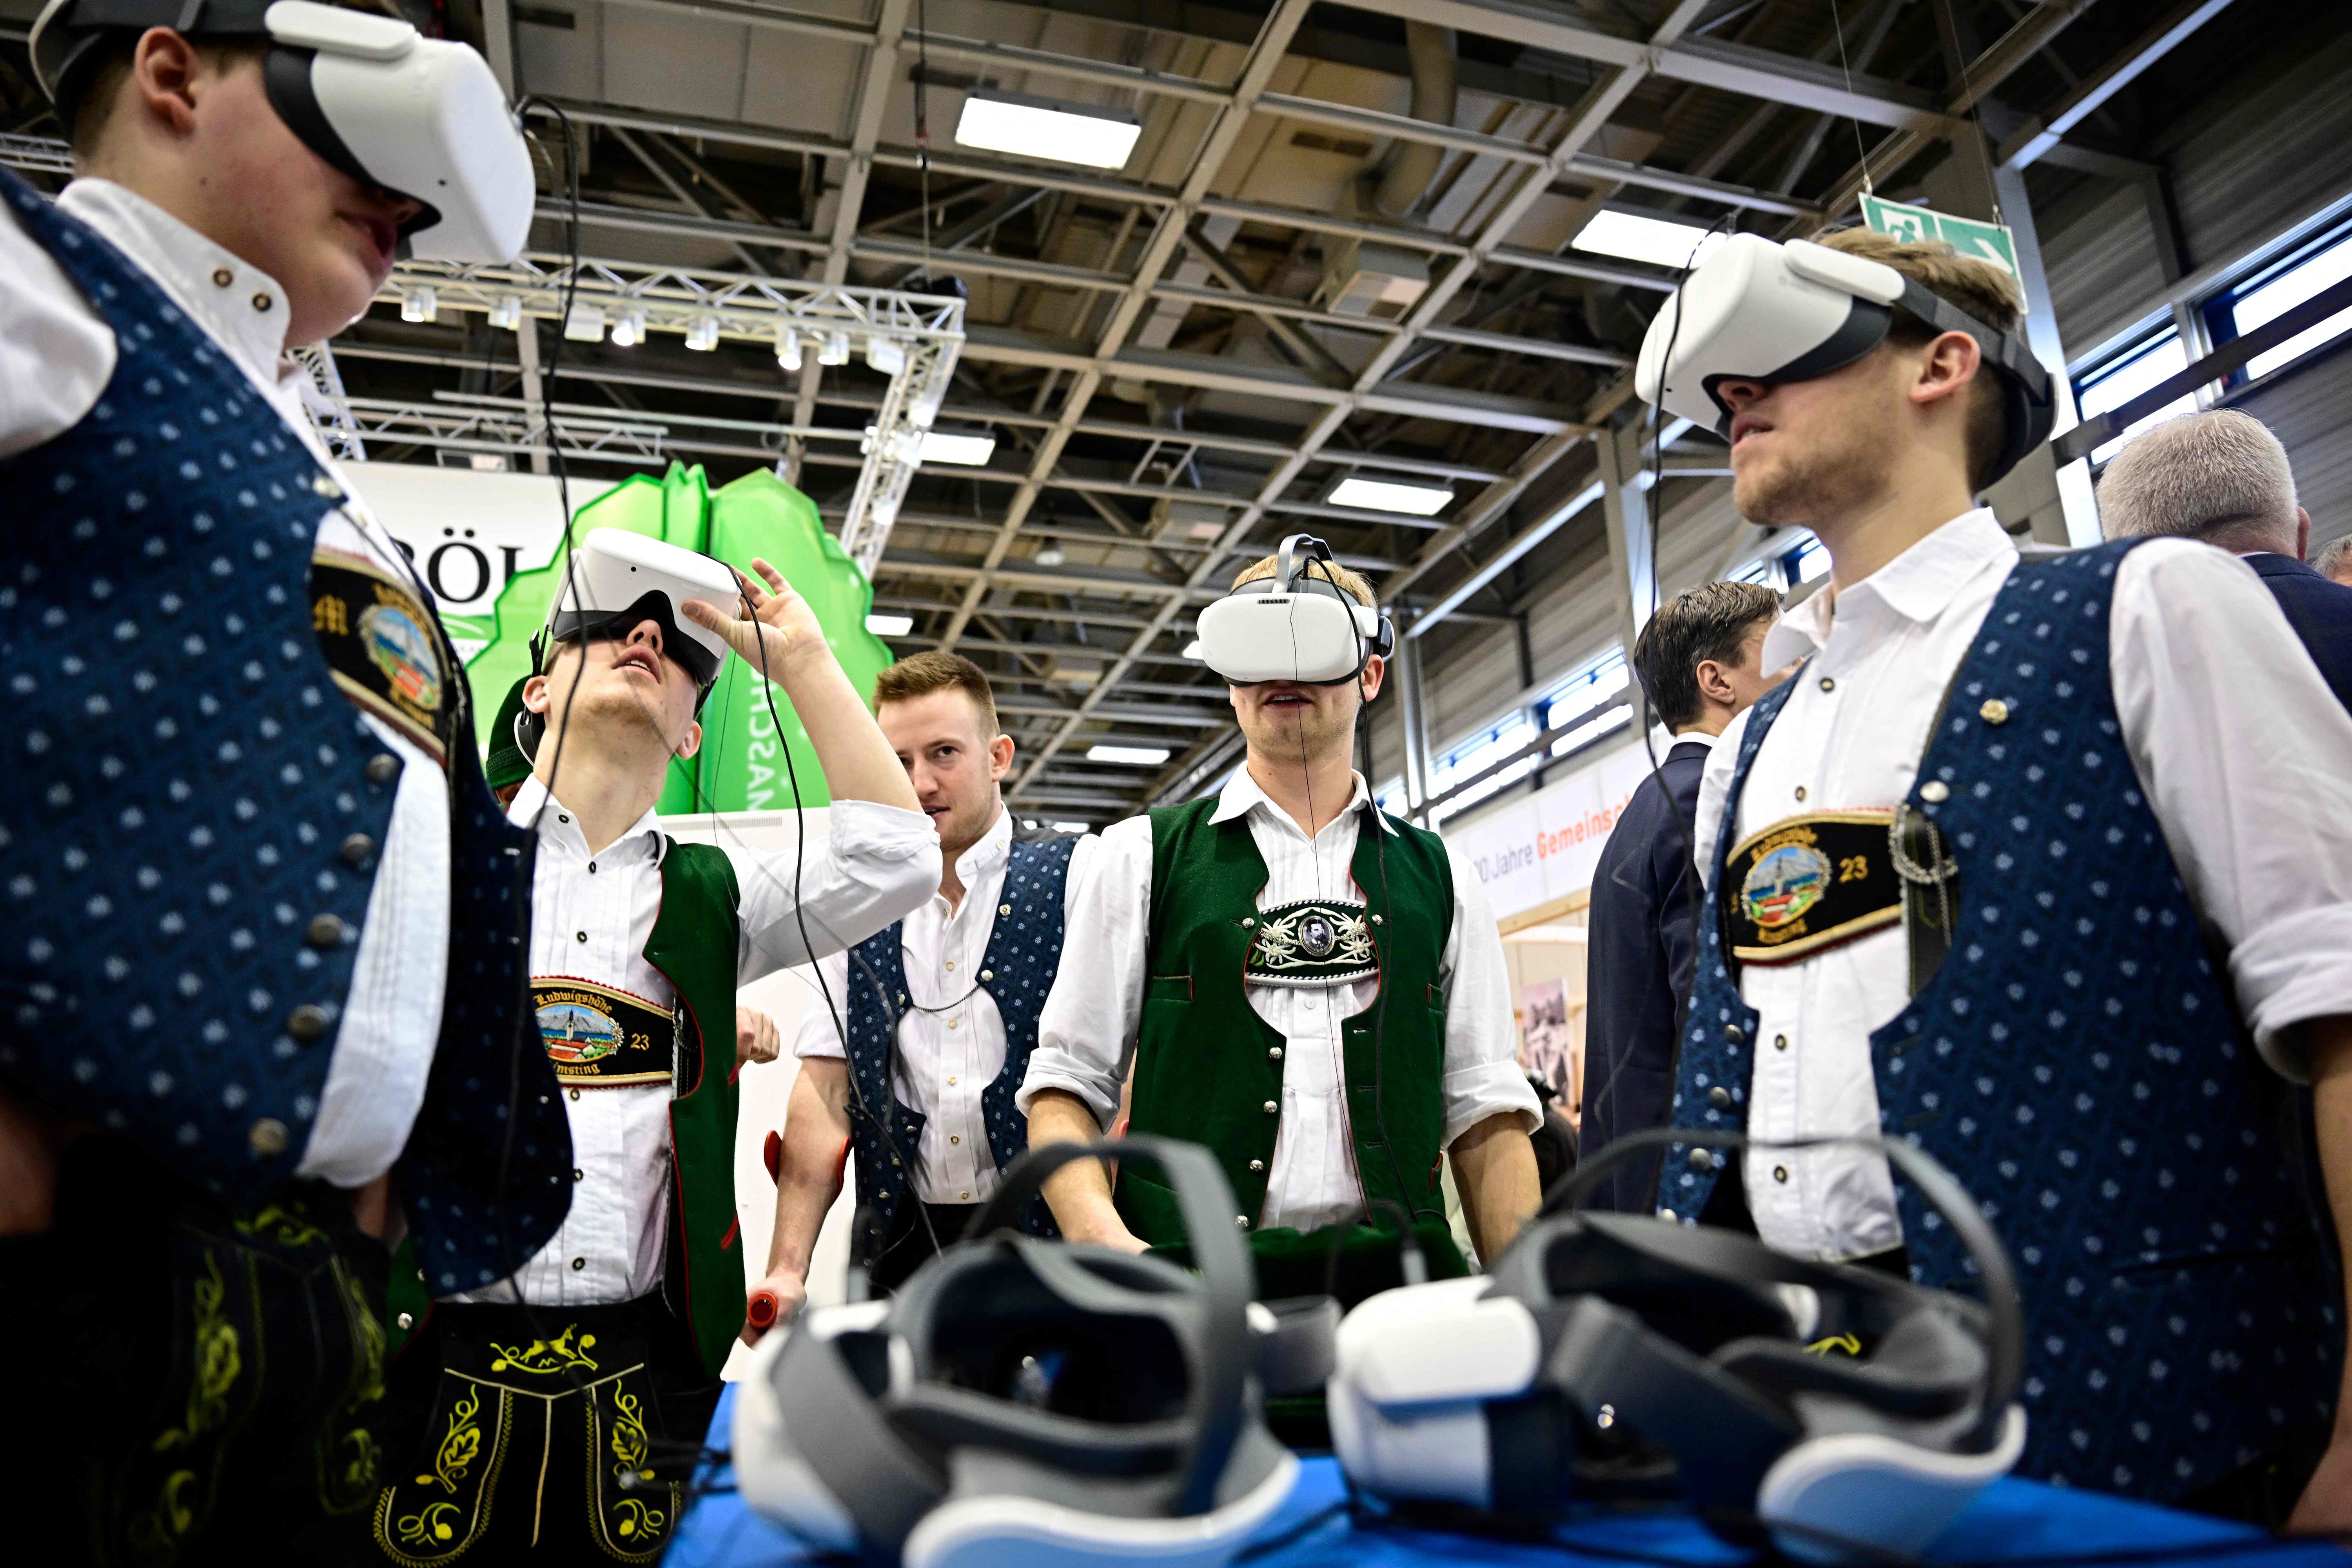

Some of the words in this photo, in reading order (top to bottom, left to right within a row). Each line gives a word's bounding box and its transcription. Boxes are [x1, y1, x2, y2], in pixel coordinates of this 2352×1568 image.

[1473, 856, 1489, 884] 0
[1492, 844, 1533, 878] Jahre
[1537, 793, 1631, 858] Gemeinsc
[1839, 856, 1868, 882] 23
[630, 1033, 650, 1051] 23
